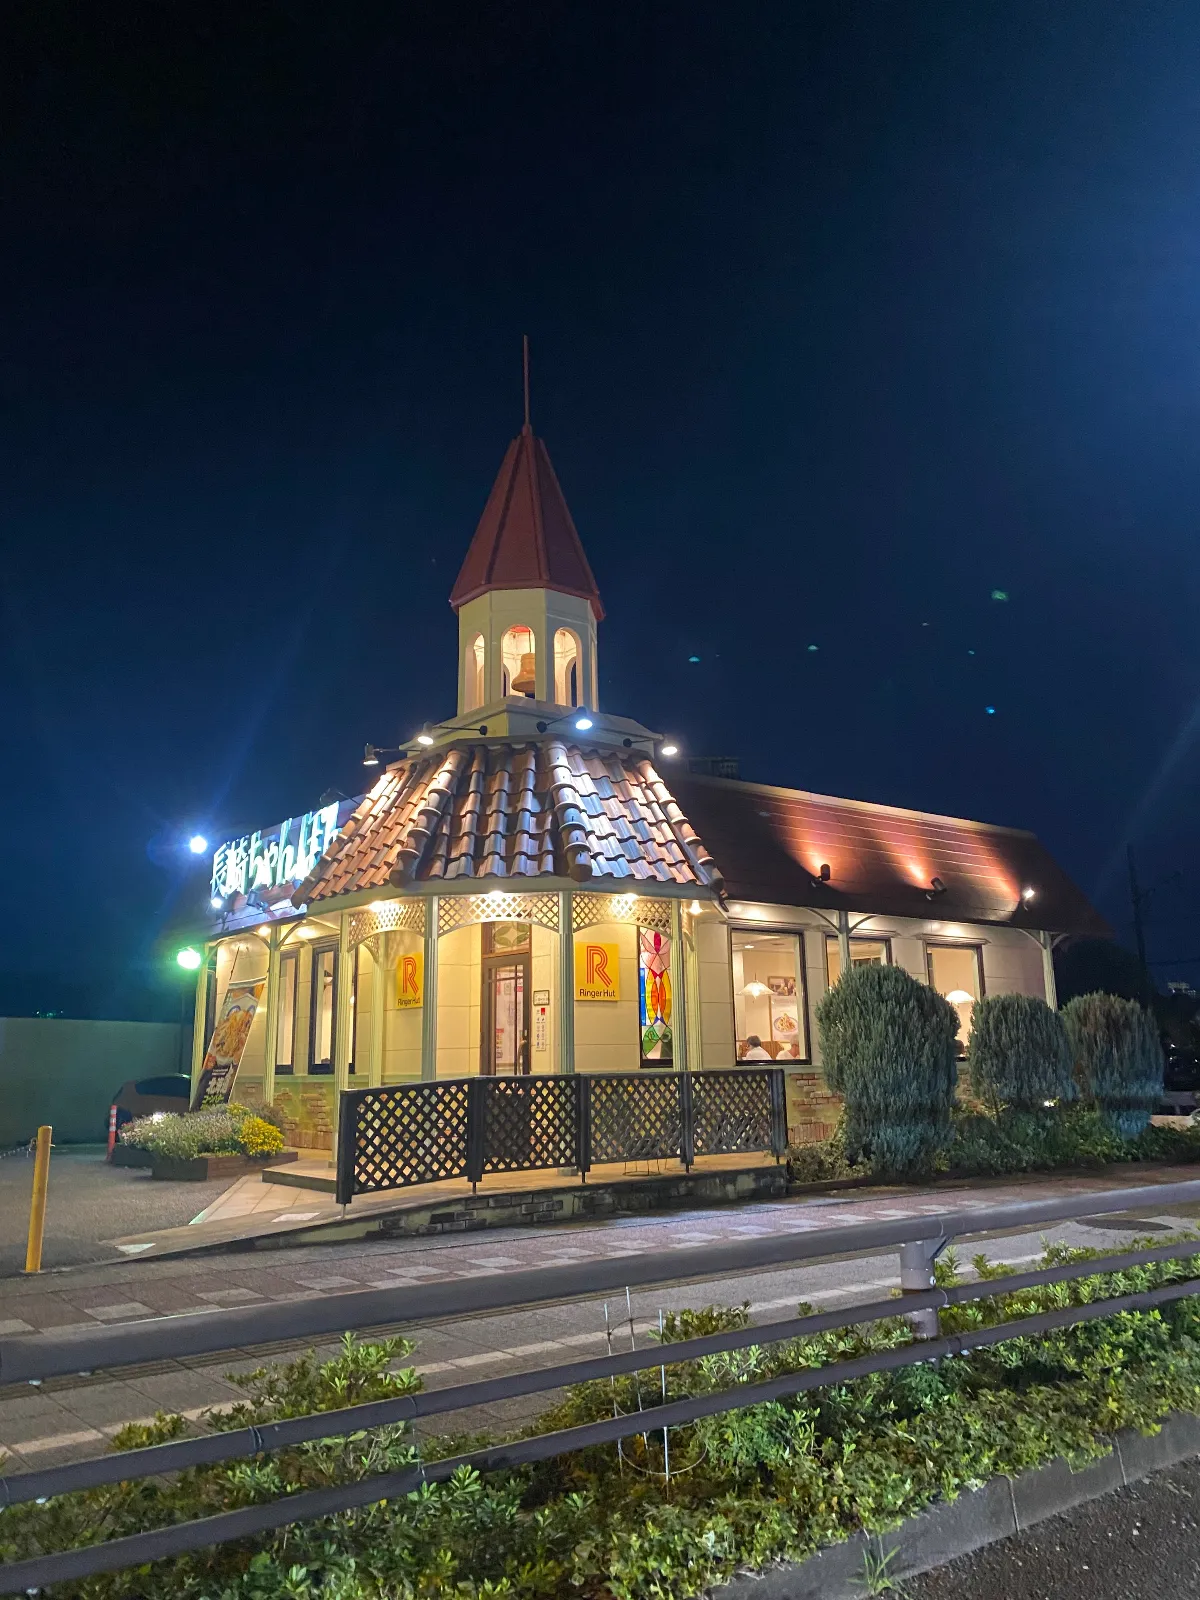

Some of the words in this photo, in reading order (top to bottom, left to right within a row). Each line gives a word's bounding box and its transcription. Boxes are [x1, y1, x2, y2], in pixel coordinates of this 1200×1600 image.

[402, 957, 419, 995] R
[586, 946, 612, 988] R
[398, 998, 413, 1006] Ringer
[579, 988, 602, 998] Ringer
[603, 989, 615, 997] Hut
